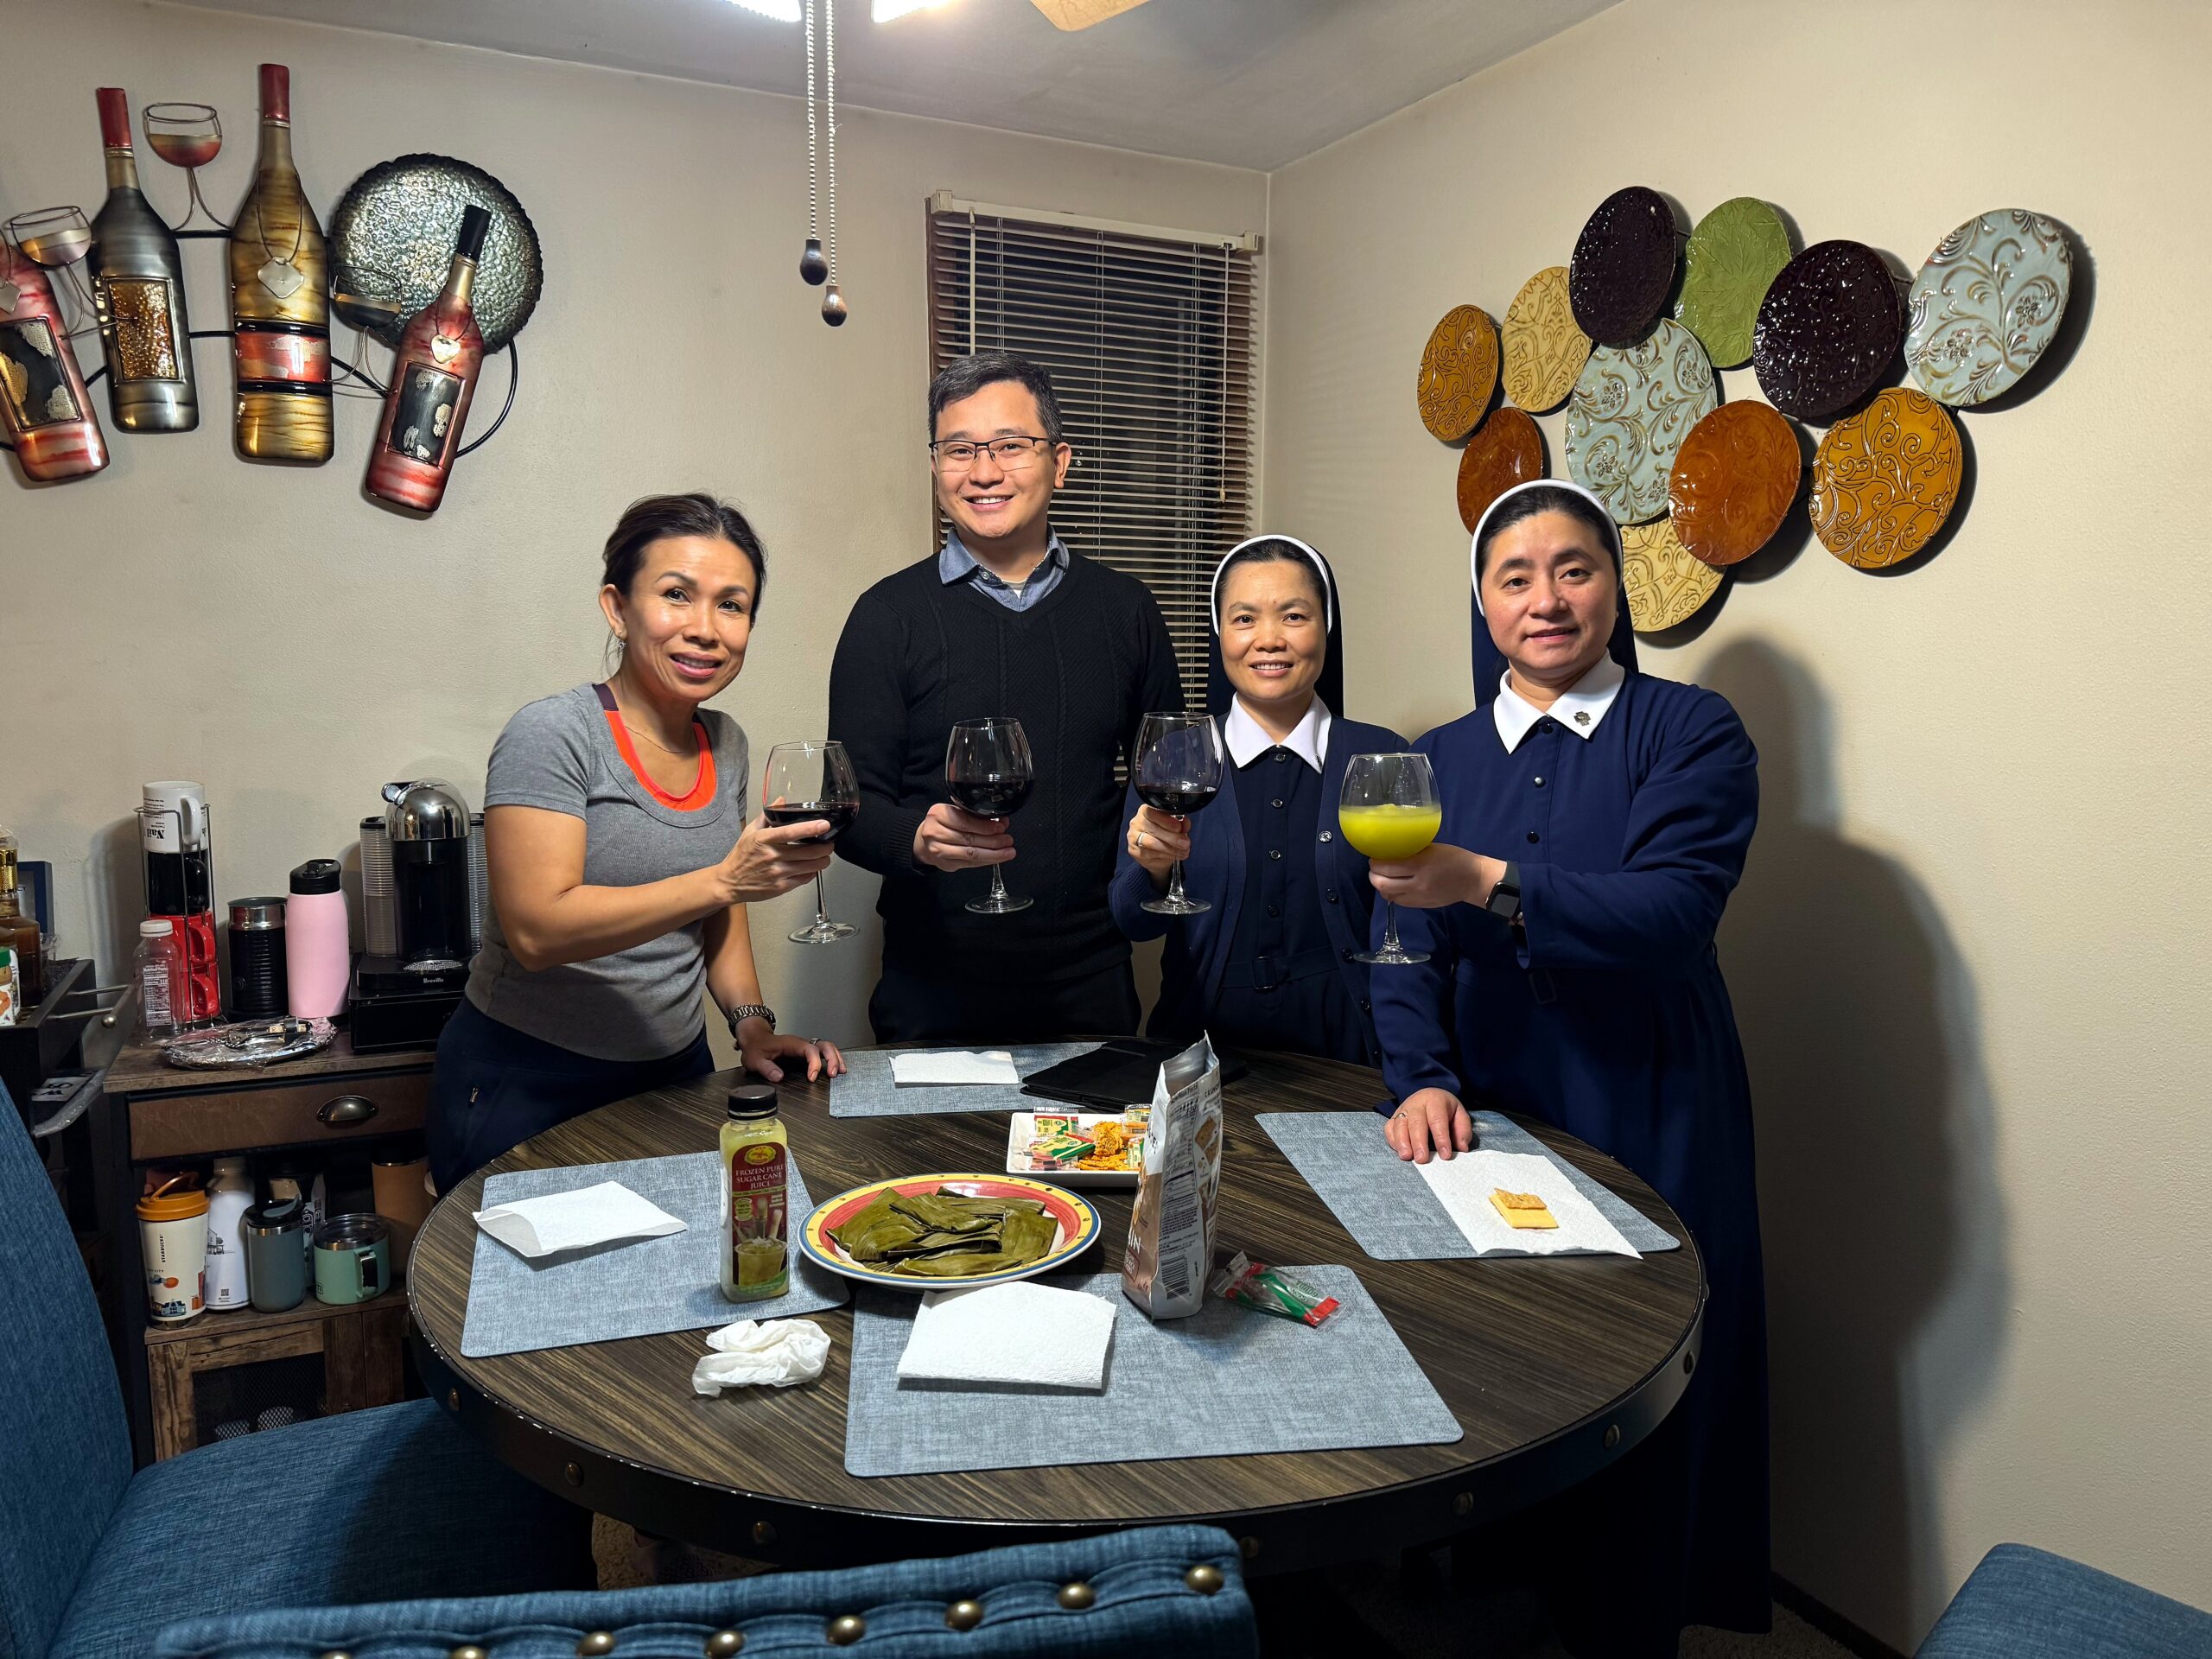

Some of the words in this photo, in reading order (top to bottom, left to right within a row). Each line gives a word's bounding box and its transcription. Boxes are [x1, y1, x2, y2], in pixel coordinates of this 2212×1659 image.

[146, 829, 165, 839] Nail
[735, 1167, 765, 1176] FROZEN
[766, 1164, 784, 1173] PURE
[762, 1171, 782, 1180] CANE
[750, 1180, 770, 1190] JUICE
